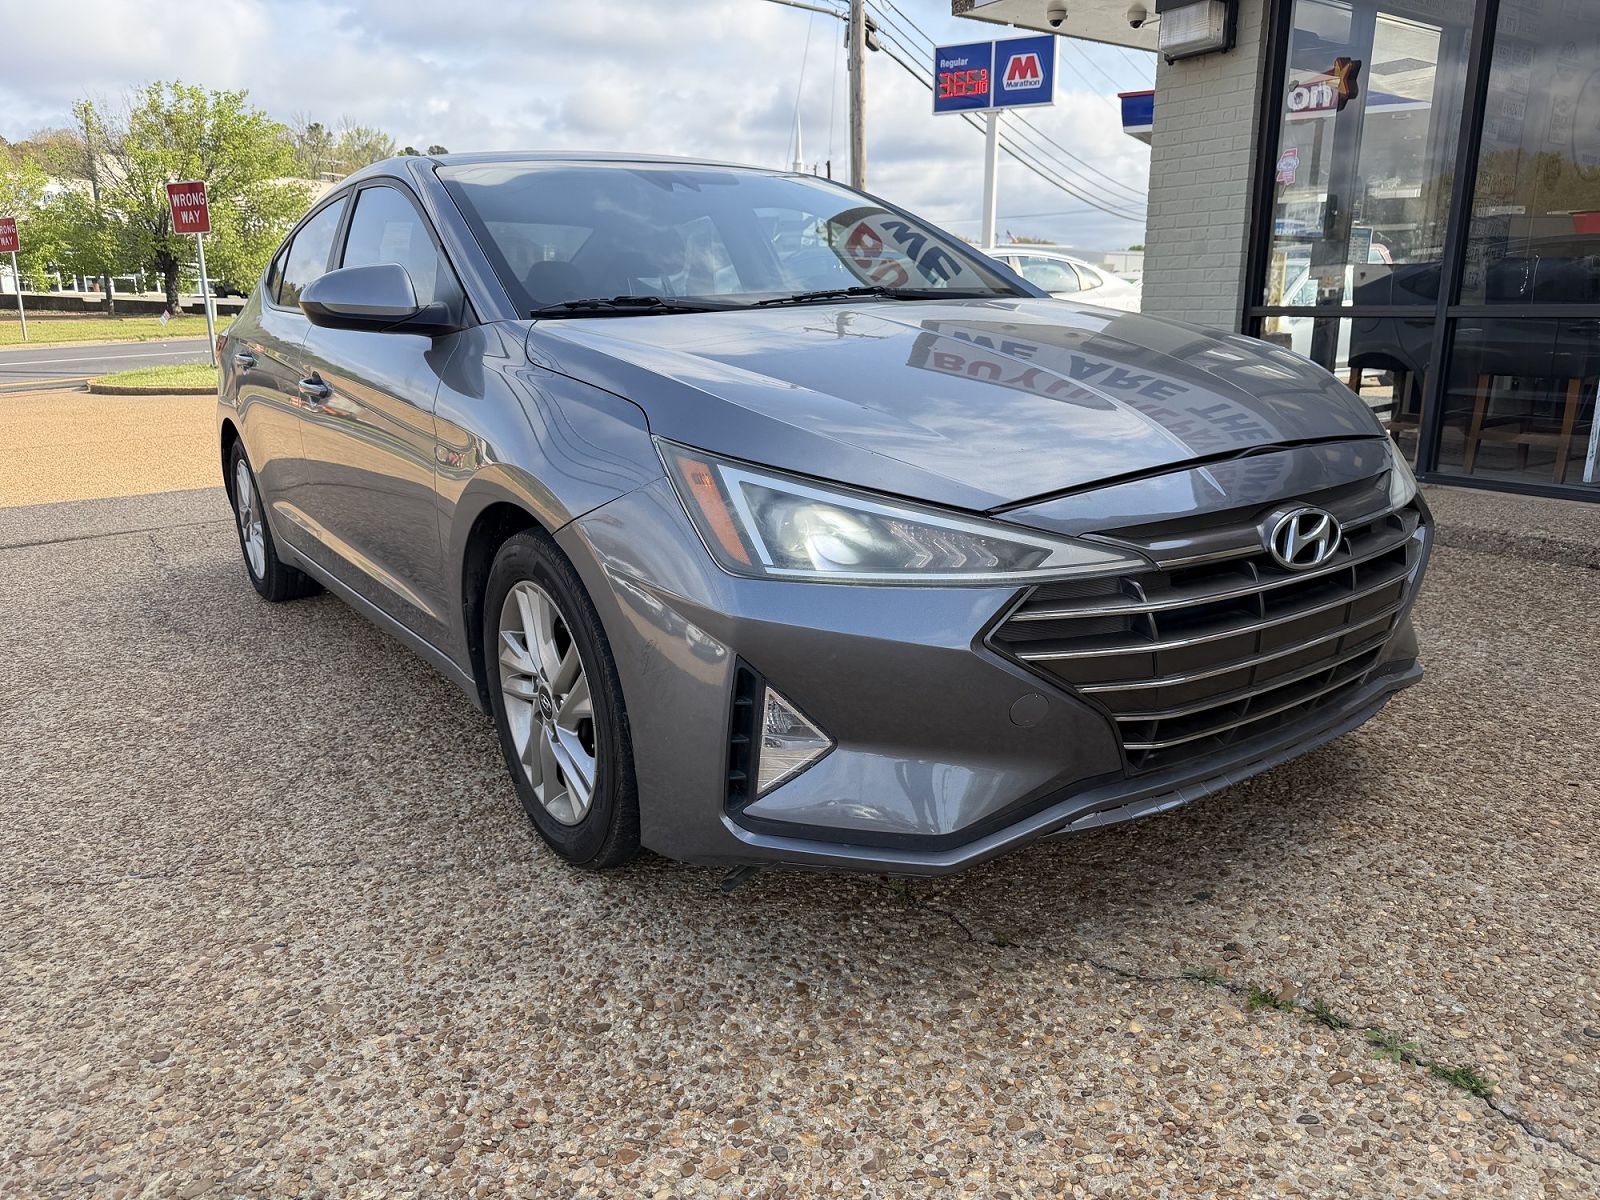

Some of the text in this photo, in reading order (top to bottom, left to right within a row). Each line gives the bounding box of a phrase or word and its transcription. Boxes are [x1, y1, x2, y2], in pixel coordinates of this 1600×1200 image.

[940, 58, 968, 69] Regular
[1005, 79, 1040, 89] Marathon
[171, 191, 205, 207] WRONG
[181, 210, 200, 224] WAY
[0, 224, 16, 235] RONG
[0, 236, 13, 246] WAY
